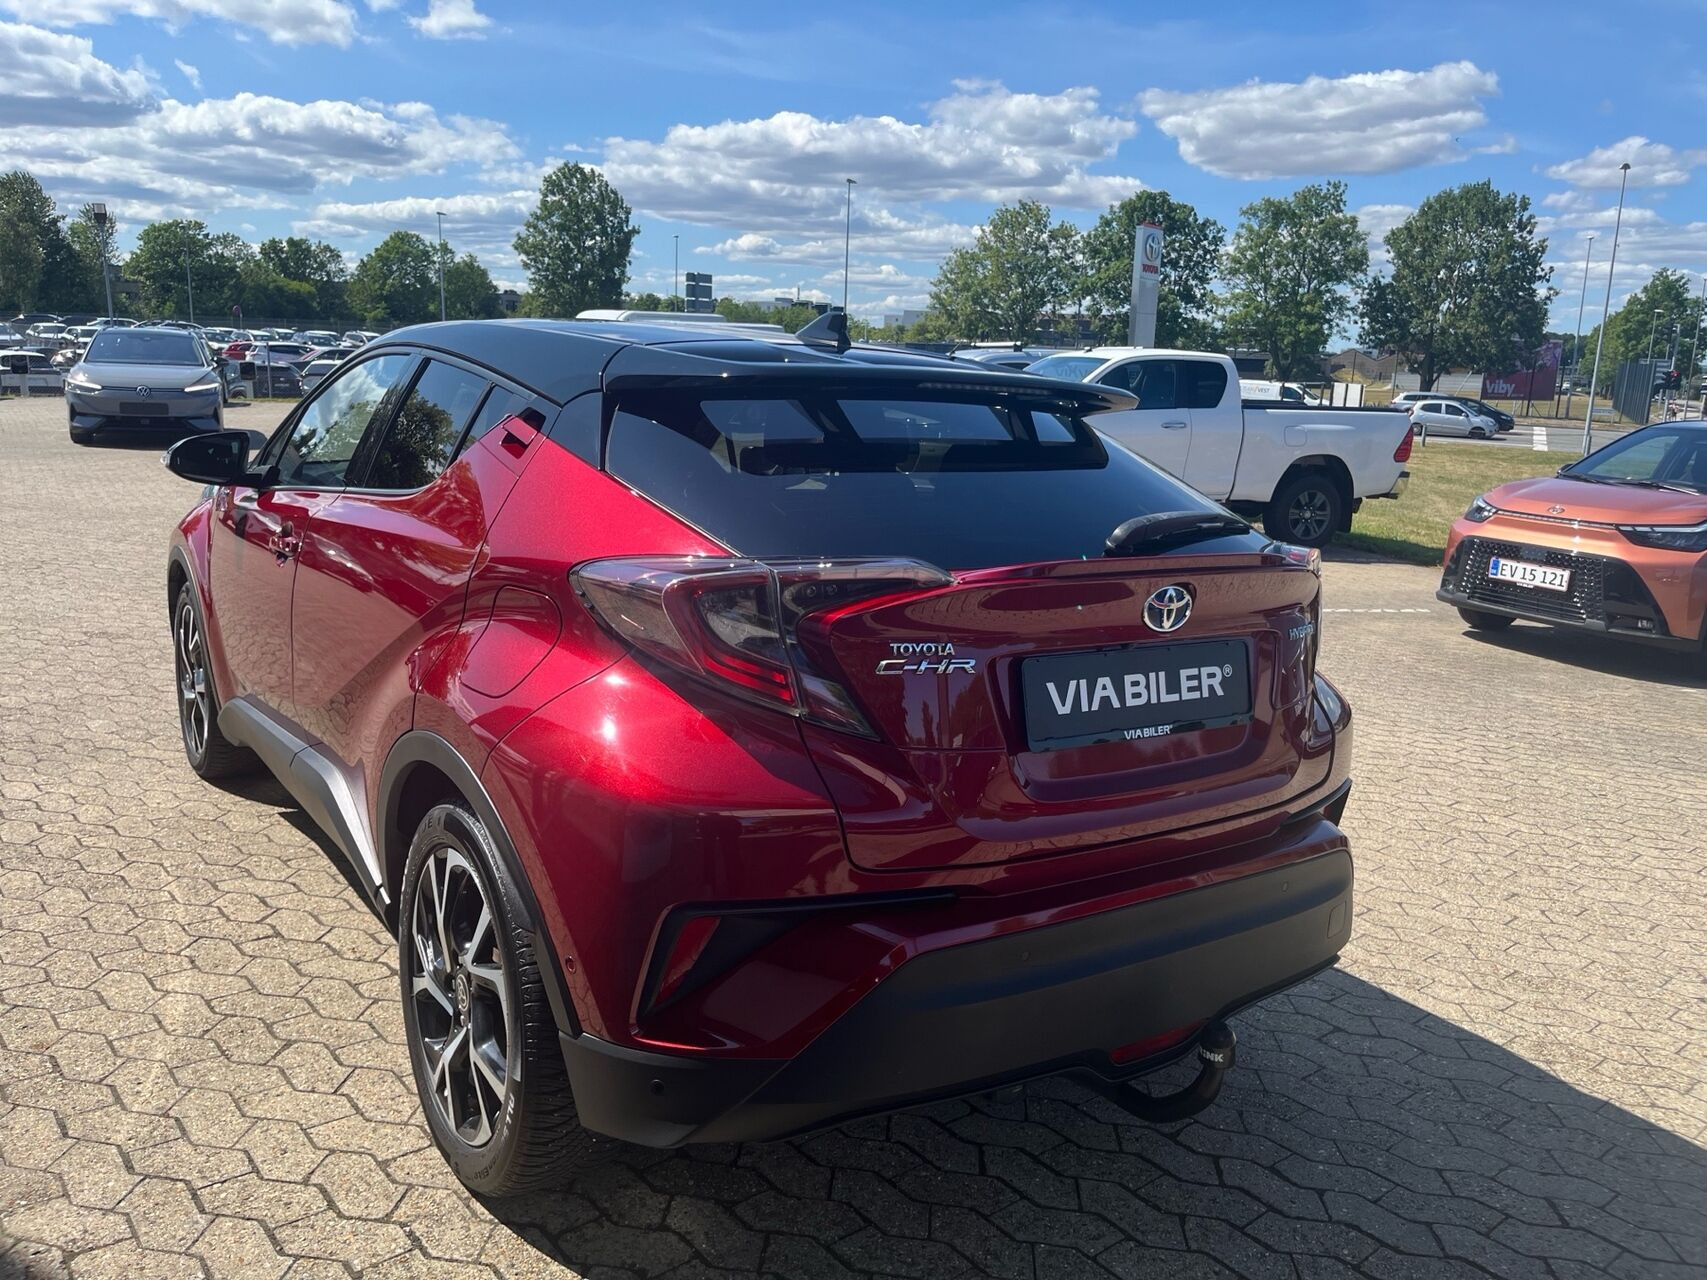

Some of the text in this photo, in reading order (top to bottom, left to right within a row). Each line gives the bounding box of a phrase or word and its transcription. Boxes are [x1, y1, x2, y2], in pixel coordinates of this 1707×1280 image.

[1486, 379, 1516, 397] viby
[1500, 563, 1518, 578] EV
[1520, 567, 1537, 582] 15
[1540, 571, 1565, 587] 121
[889, 643, 955, 656] TOYOTA
[875, 659, 976, 674] C-HR
